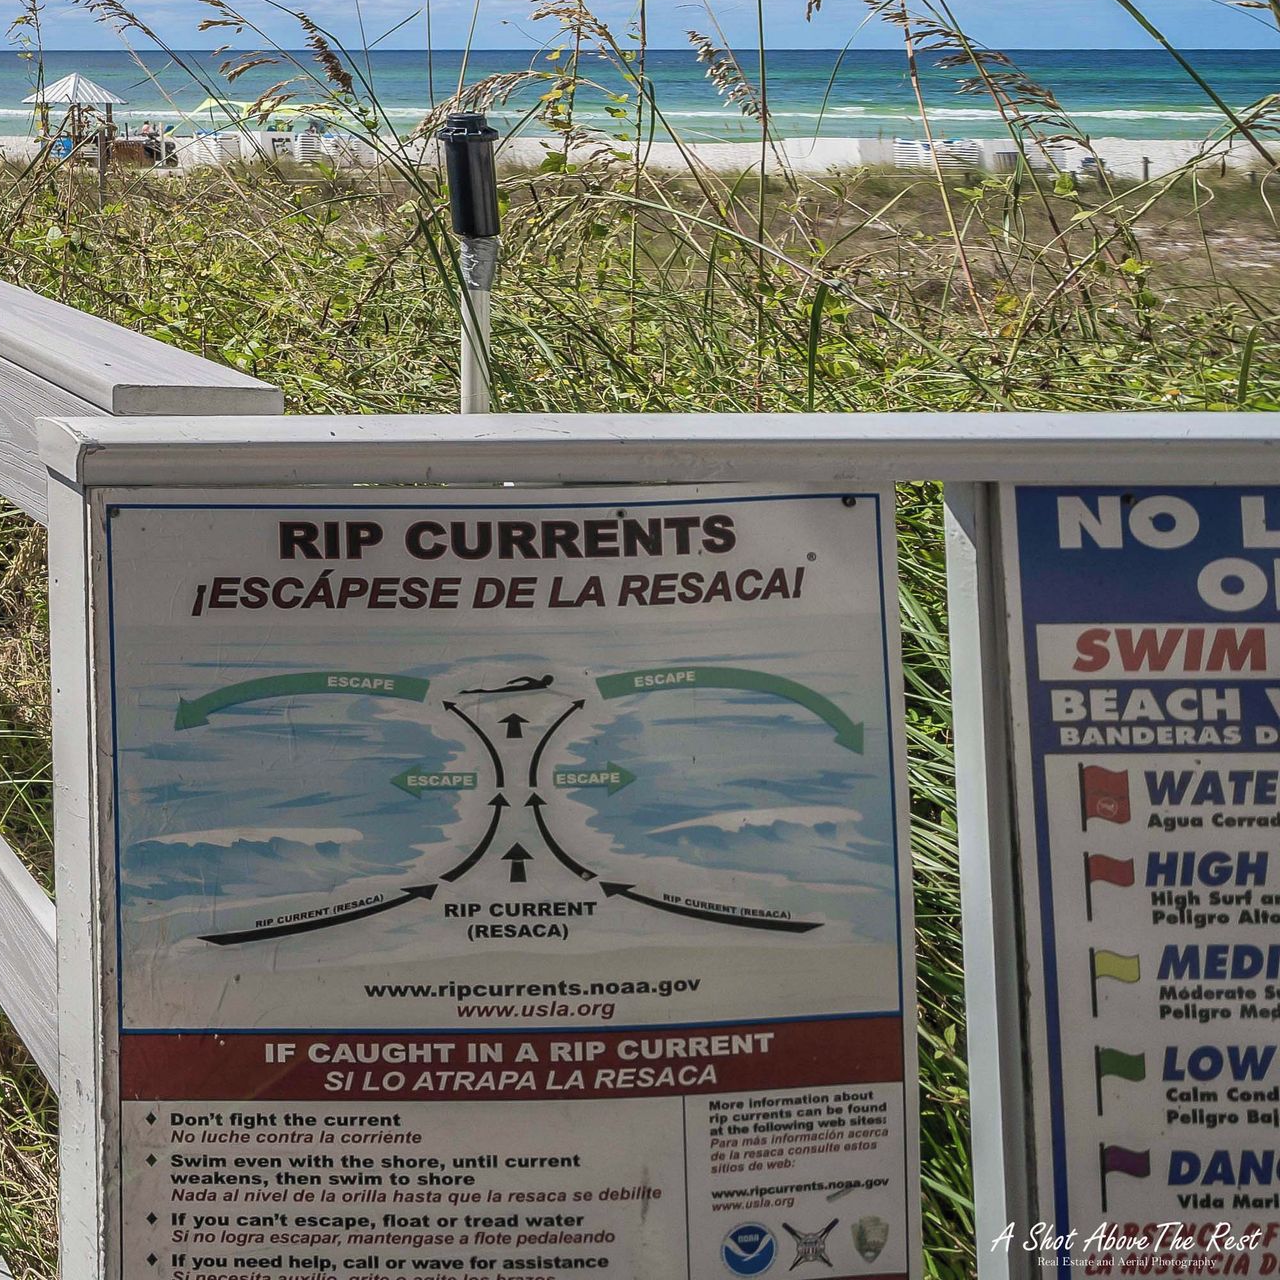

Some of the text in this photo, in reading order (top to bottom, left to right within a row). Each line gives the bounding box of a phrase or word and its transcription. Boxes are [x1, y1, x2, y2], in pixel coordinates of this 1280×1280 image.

[1057, 495, 1200, 550] NO
[279, 515, 736, 560] RIP CURRENTS
[191, 567, 805, 616] ¡ESCÁPESE DE LA RESACA!
[1072, 628, 1267, 672] SWIM
[327, 676, 395, 691] ESCAPE
[634, 670, 696, 688] ESCAPE
[1051, 687, 1241, 721] BEACH
[1060, 726, 1241, 746] BANDERAS
[407, 774, 473, 787] ESCAPE
[556, 772, 620, 786] ESCAPE
[1144, 770, 1279, 806] WATE
[1147, 813, 1203, 832] Agua
[1145, 851, 1269, 887] HIGH
[444, 901, 597, 918] RIP CURRENT
[663, 893, 791, 920] RIP CURRENT (RESACA)
[1151, 889, 1253, 910] High Surf
[255, 894, 384, 928] RIP CURRENT (RESACA)
[1152, 909, 1230, 929] Peligro
[467, 924, 569, 942] (RESACA)
[364, 978, 701, 1001] www.ripcurrents.noaa.gov
[1159, 985, 1256, 1001] Moderate
[457, 1001, 616, 1019] www.usla.org
[1159, 1003, 1234, 1023] Peligro
[265, 1032, 775, 1063] IF CAUGHT IN A RIP CURRENT
[1162, 1045, 1278, 1081] LOW
[324, 1064, 717, 1091] SI LO ATRAPA LA RESACA
[709, 1091, 873, 1111] More information about
[1166, 1086, 1218, 1102] Calm
[171, 1113, 401, 1129] Don't fight the current
[709, 1102, 886, 1125] rip currents can be found
[1166, 1108, 1239, 1128] Peligro
[710, 1115, 886, 1136] at the following web sites:
[171, 1131, 195, 1143] No
[201, 1130, 250, 1143] luche
[256, 1131, 313, 1144] contra
[319, 1130, 335, 1144] la
[710, 1128, 889, 1149] Para más información acerca
[711, 1141, 877, 1161] de la resaca consulte estos
[171, 1154, 581, 1171] Swim even with the shore, until current
[711, 1159, 795, 1174] sitios de web:
[171, 1172, 475, 1187] weakens, then swim to shore
[712, 1178, 889, 1199] www.ripcurrents.noaa.gov
[171, 1187, 662, 1206] Nada al nivel de la orilla hasta que la resaca se debilite
[712, 1197, 795, 1211] www.usla.org
[1177, 1194, 1224, 1209] Vida
[171, 1213, 584, 1230] If you can't escape, float or tread water
[171, 1230, 615, 1248] Si no logra escapar, mantengase a flote pedaleando
[171, 1254, 609, 1271] If you need help, call or wave for assistance
